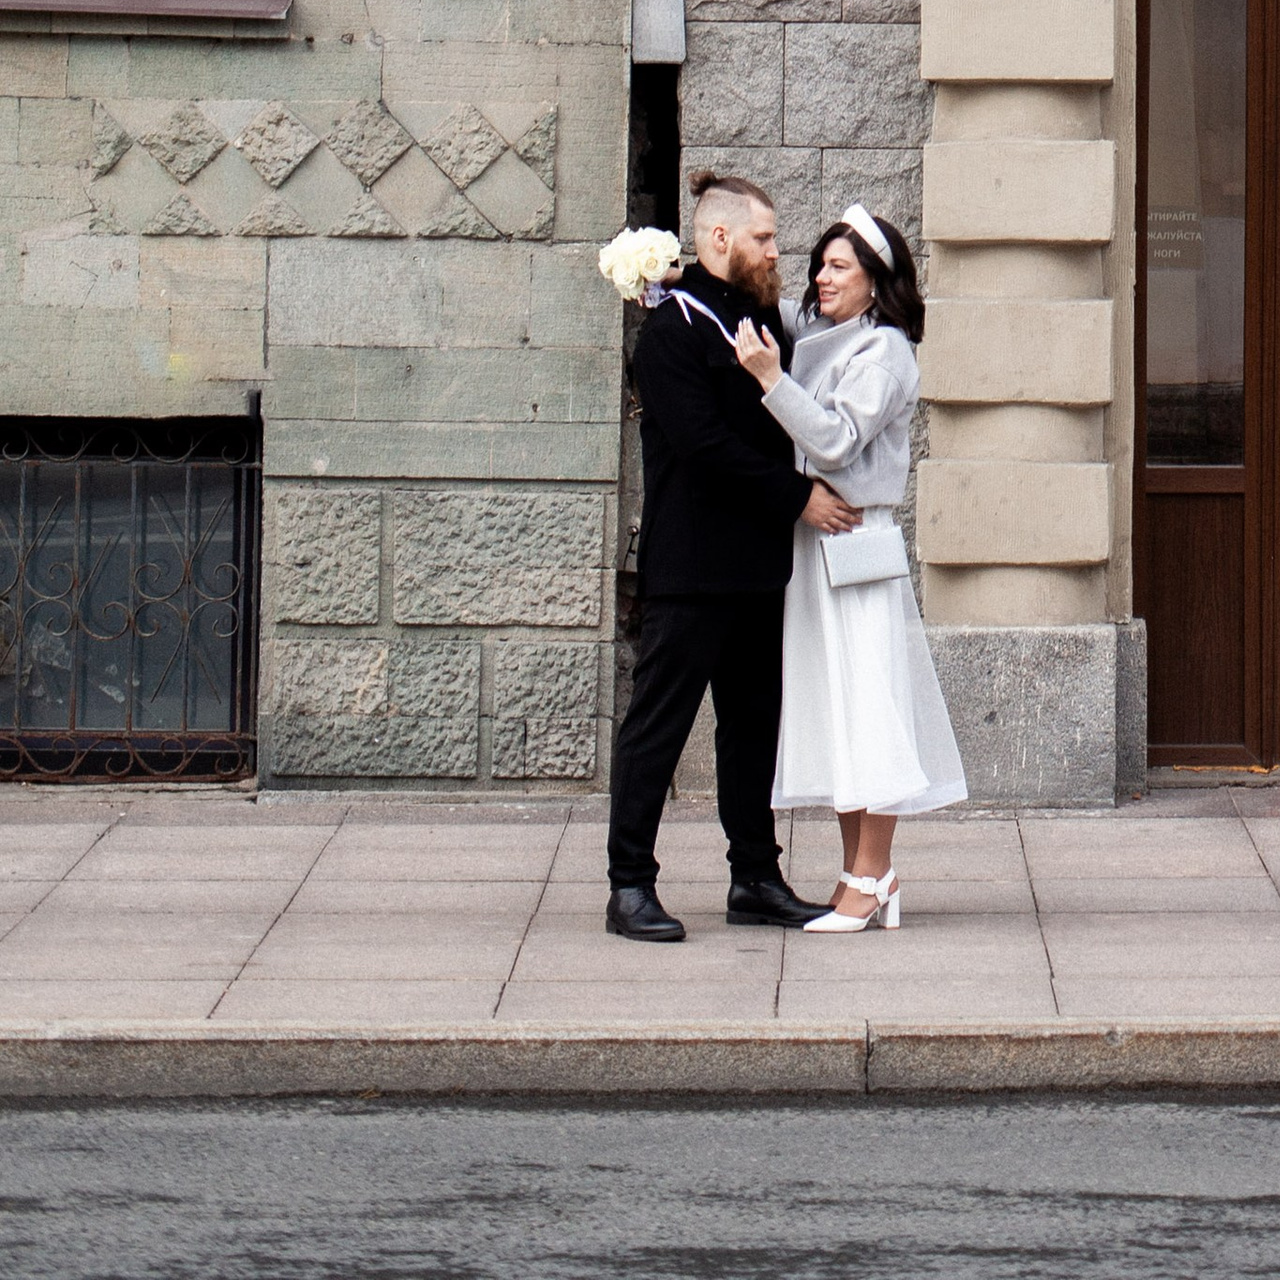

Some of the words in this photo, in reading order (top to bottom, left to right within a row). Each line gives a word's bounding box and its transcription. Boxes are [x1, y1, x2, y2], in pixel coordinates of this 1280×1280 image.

[1149, 211, 1198, 222] ЫТИРАЙТЕ
[1149, 230, 1202, 241] ЖАЛУЙСТА
[1154, 249, 1181, 258] НОГИ
